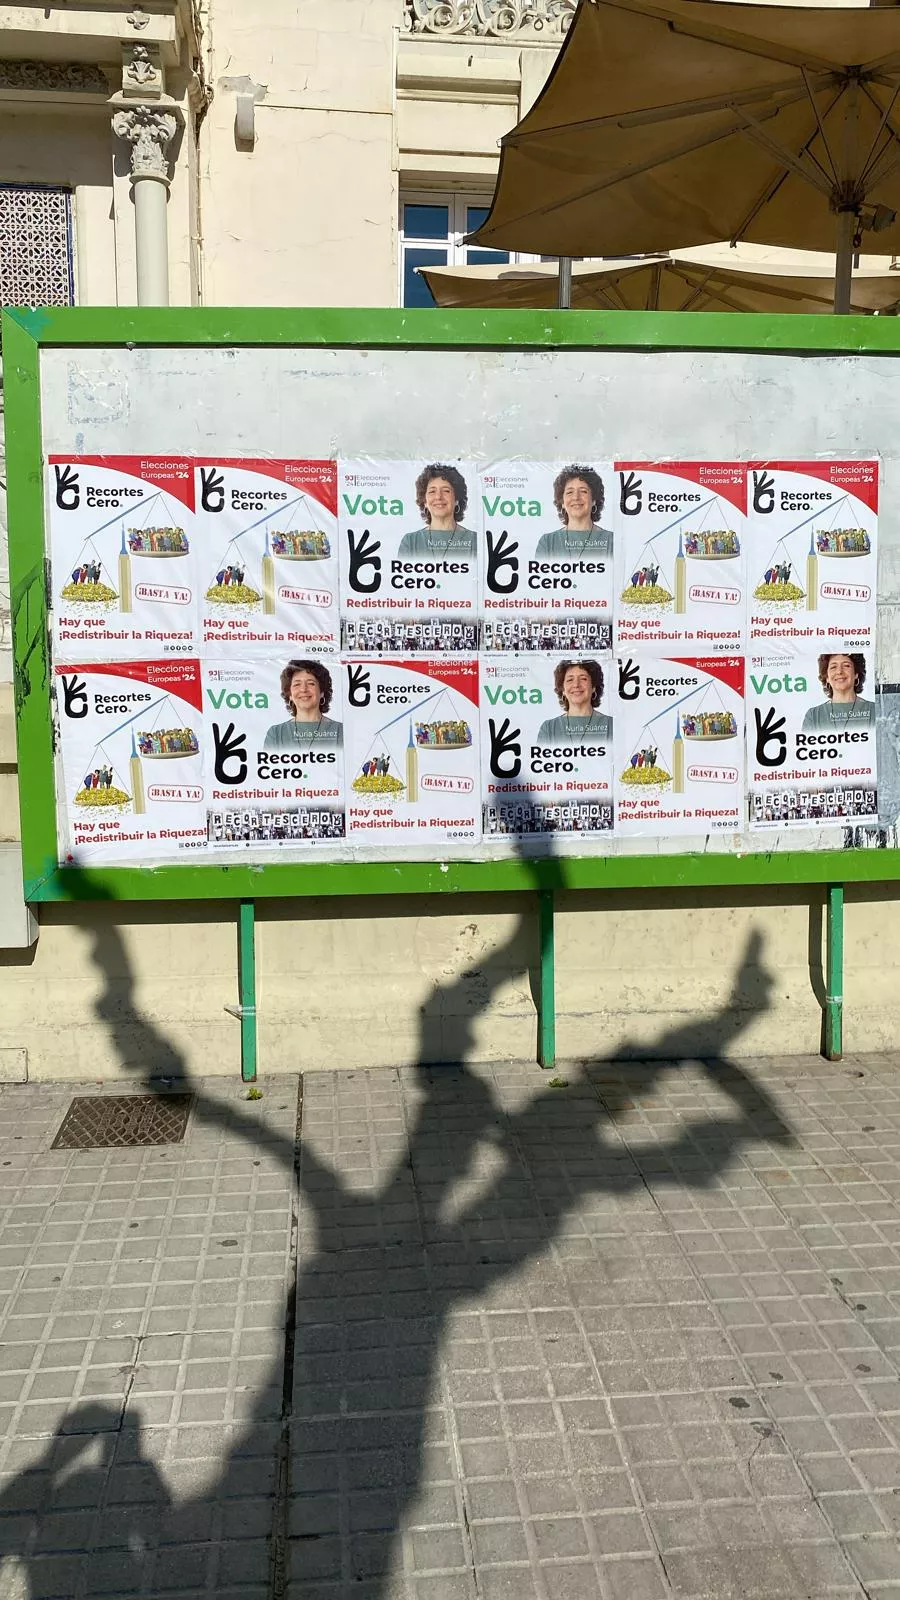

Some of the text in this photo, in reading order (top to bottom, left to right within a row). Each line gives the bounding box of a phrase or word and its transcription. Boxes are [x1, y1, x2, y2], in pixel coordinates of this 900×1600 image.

[140, 461, 189, 470] Elecciones
[285, 465, 332, 474] Elecciones
[699, 467, 743, 475] Elecciones
[830, 466, 873, 474] Elecciones
[86, 487, 143, 497] Recortes
[232, 490, 287, 500] Recortes
[648, 492, 700, 502] Recortes
[781, 491, 832, 501] Recortes
[86, 497, 123, 508] Cero.
[232, 500, 267, 511] Cero.
[343, 494, 404, 516] Vota
[482, 496, 541, 517] Vota
[648, 502, 682, 512] Cero.
[781, 501, 813, 511] Cero.
[391, 560, 469, 573] Recortes
[528, 561, 605, 573] Recortes
[391, 575, 441, 589] Cero.
[528, 575, 577, 589] Cero.
[174, 591, 188, 601] YA!
[315, 593, 329, 604] YA!
[724, 592, 738, 601] YA!
[855, 589, 868, 598] YA!
[347, 599, 472, 610] Redistribuir la Riqueza
[484, 599, 608, 610] Redistribuir la Riqueza
[59, 618, 105, 628] Hay que
[203, 619, 249, 629] Hay que
[618, 619, 661, 629] Hay que
[751, 616, 793, 626] Hay que
[59, 629, 192, 641] ¡Redistribuir la Riqueza!
[203, 631, 272, 642] ¡Redistribuir
[275, 632, 285, 641] la
[617, 631, 741, 641] ¡Redistribuir la Riqueza!
[751, 627, 871, 638] ¡Redistribuir la Riqueza!
[147, 665, 195, 673] Elecciones
[646, 677, 698, 686] Recortes
[750, 675, 808, 695] Vota
[377, 685, 430, 694] Recortes
[484, 685, 543, 705] Vota
[646, 686, 679, 696] Cero.
[95, 692, 152, 703] Recortes
[207, 689, 269, 709] Vota
[377, 694, 411, 703] Cero.
[95, 703, 131, 714] Cero.
[796, 731, 868, 746] Recortes
[257, 751, 335, 765] Recortes
[531, 746, 606, 759] Recortes
[796, 746, 843, 761] Cero.
[531, 759, 578, 773] Cero.
[258, 765, 308, 780] Cero.
[722, 771, 735, 779] YA!
[754, 767, 871, 781] Redistribuir la Riqueza
[457, 780, 470, 790] YA!
[488, 781, 608, 793] Redistribuir la Riqueza
[186, 790, 200, 800] YA!
[213, 788, 339, 799] Redistribuir la Riqueza
[618, 799, 660, 808] Hay que
[349, 807, 393, 817] Hay que
[684, 809, 692, 818] la
[694, 808, 738, 818] Riqueza!
[73, 820, 120, 832] Hay que
[350, 818, 474, 830] ¡Redistribuir la Riqueza!
[75, 828, 207, 845] ¡Redistribuir la Riqueza!
